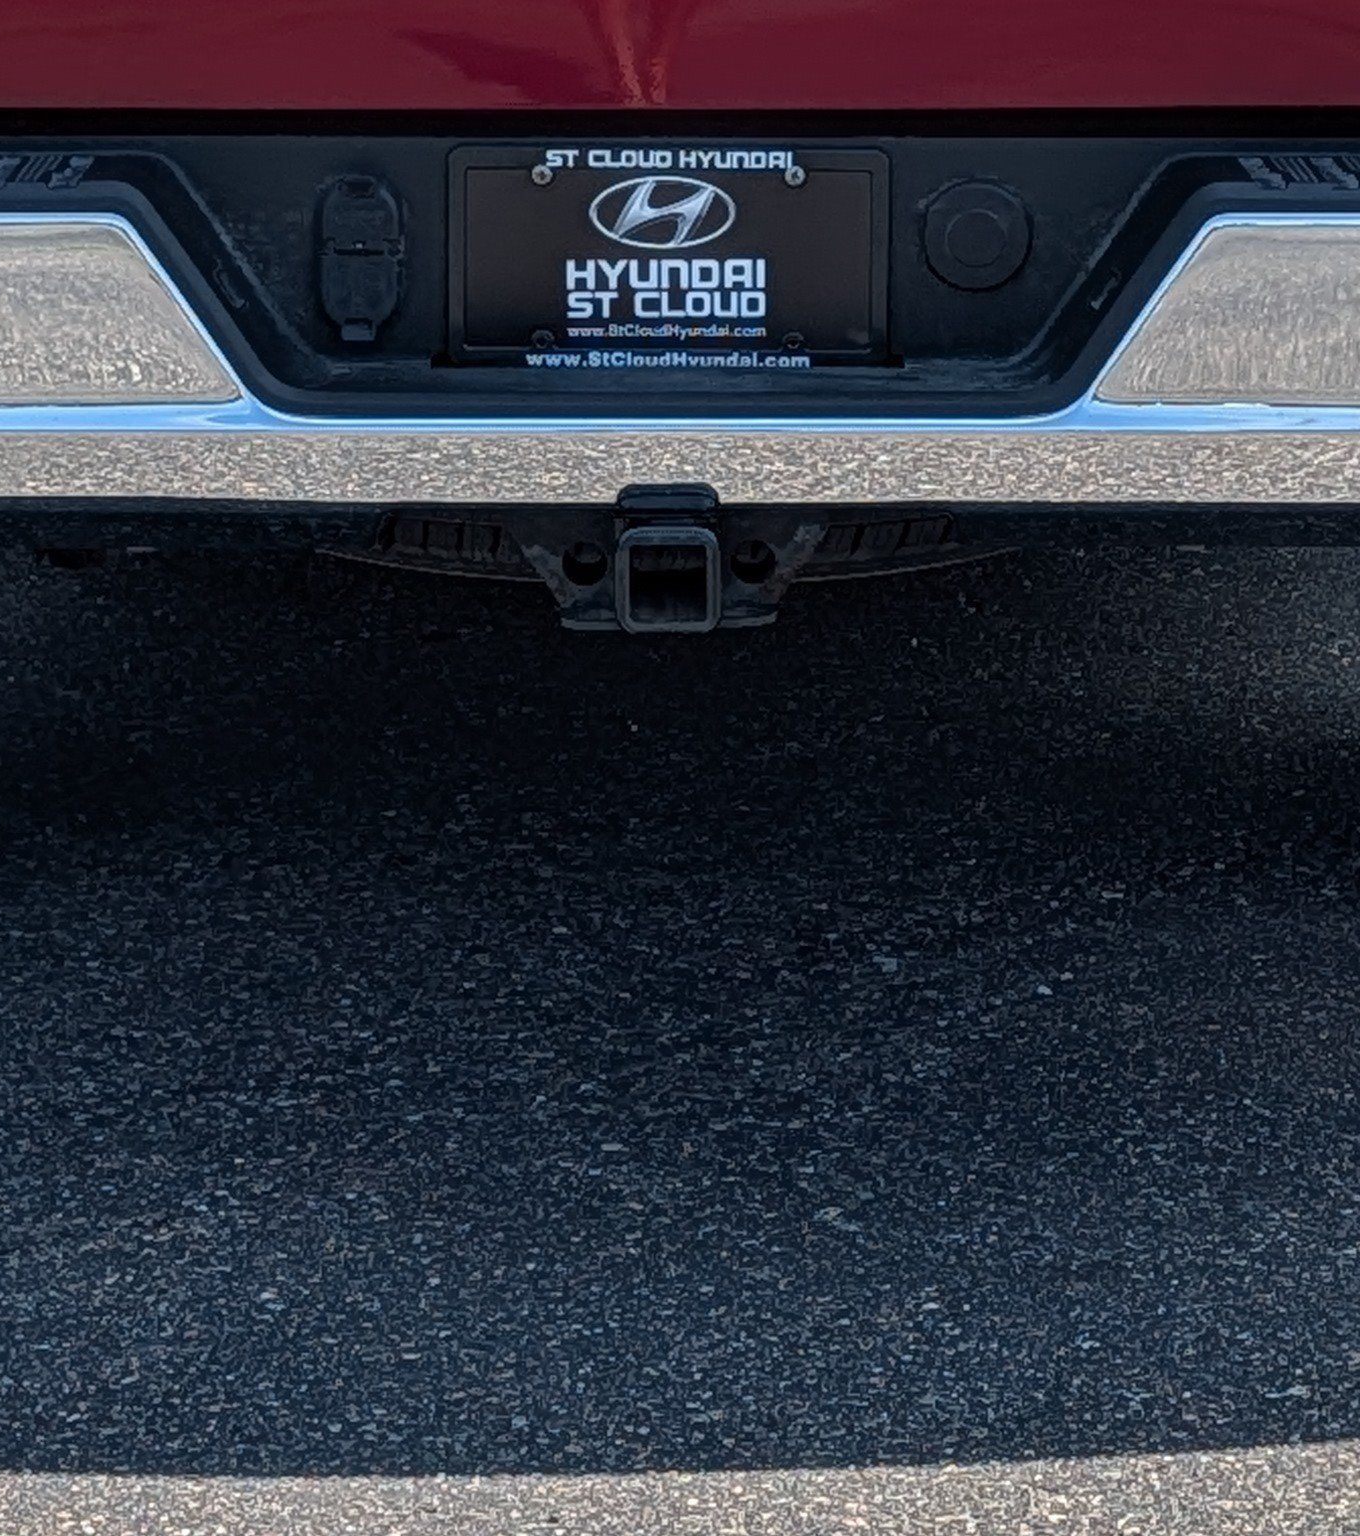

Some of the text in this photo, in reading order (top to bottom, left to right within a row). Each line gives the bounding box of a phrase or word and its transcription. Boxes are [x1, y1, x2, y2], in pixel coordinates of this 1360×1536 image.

[545, 149, 793, 169] ST CLOUD HYUNDAI
[565, 258, 767, 290] HYUNDAI
[566, 292, 767, 318] ST CLOUD
